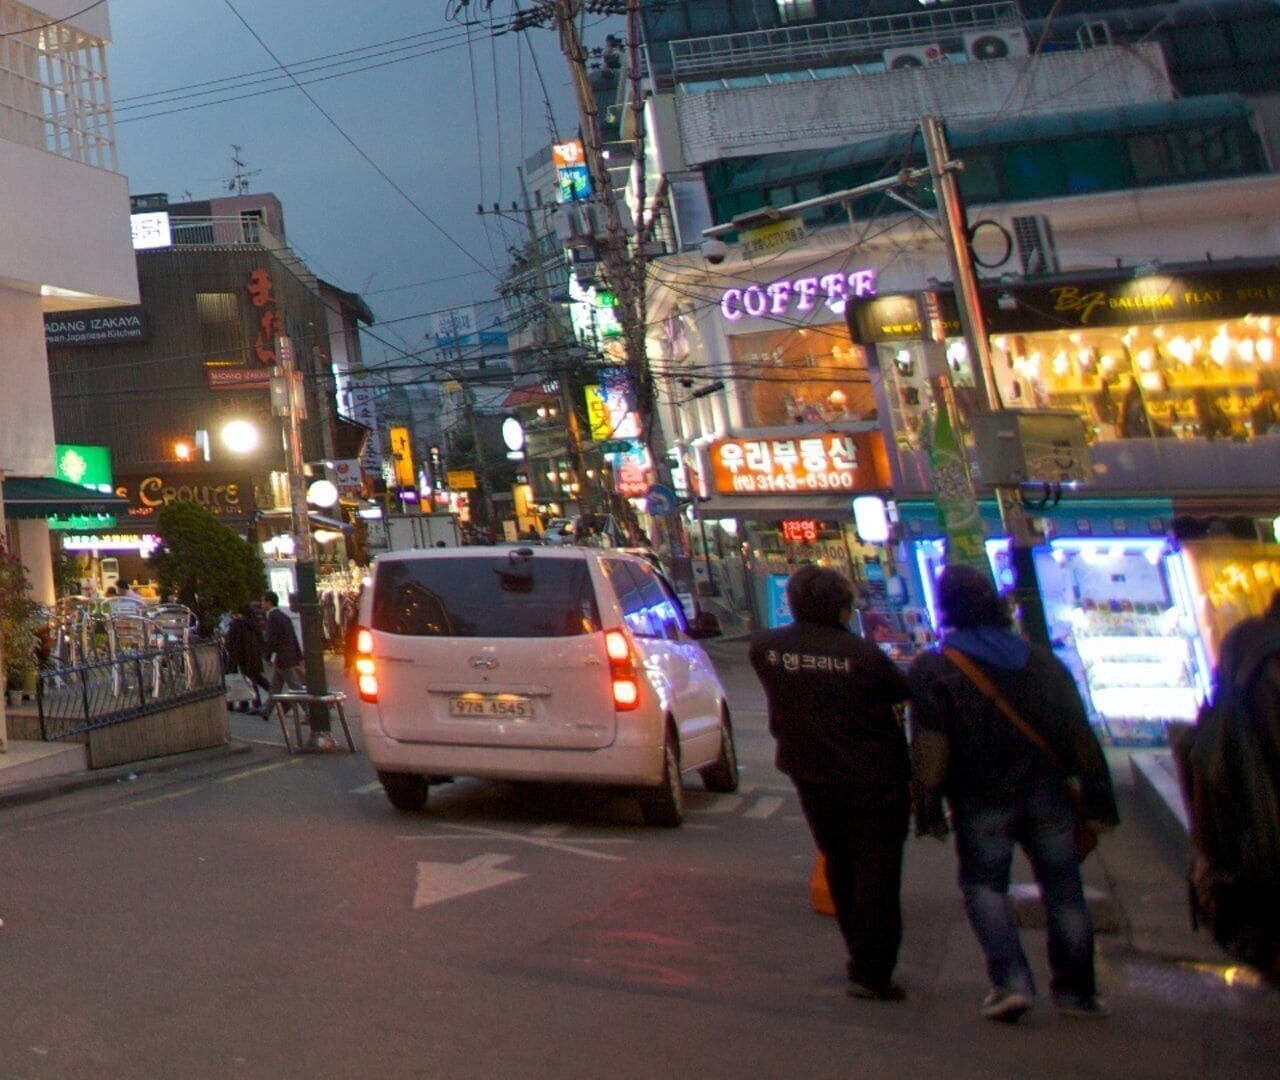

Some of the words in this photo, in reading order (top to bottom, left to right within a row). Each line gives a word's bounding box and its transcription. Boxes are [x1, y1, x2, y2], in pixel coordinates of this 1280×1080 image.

[721, 270, 878, 320] COFFEE
[91, 316, 141, 329] IZAKAYA
[107, 328, 142, 338] Kitchen
[720, 437, 858, 473] 우리부동산
